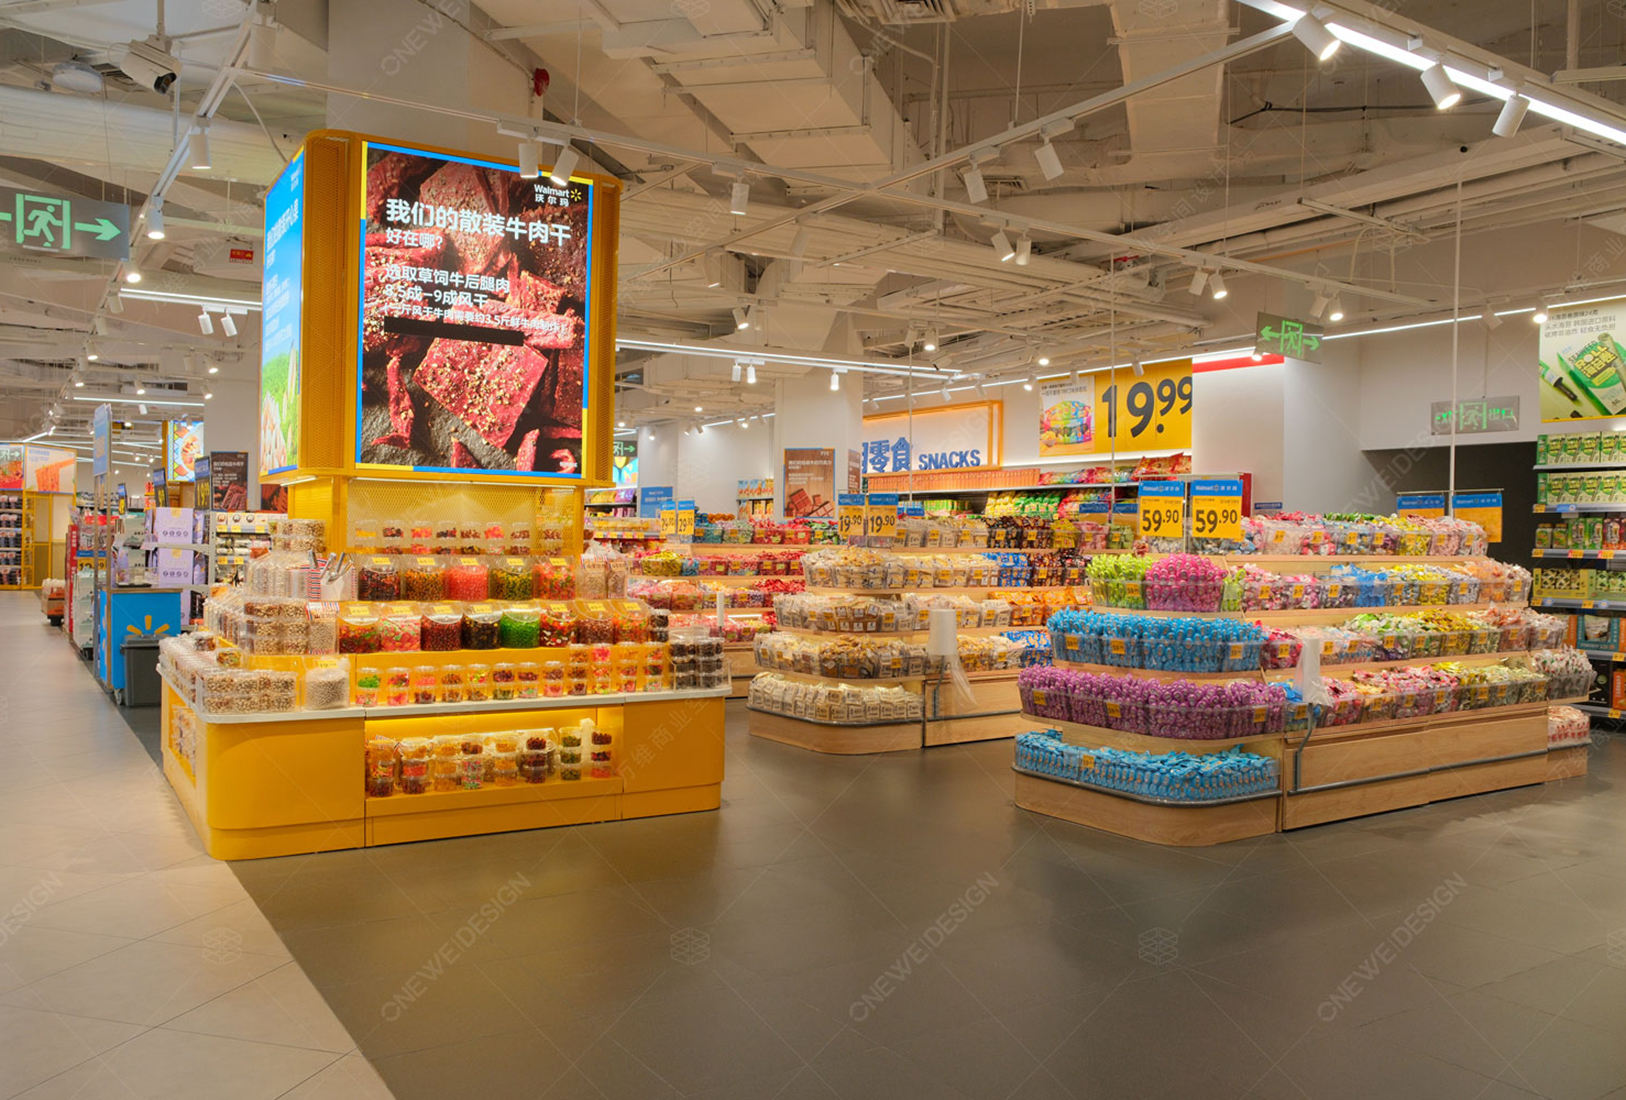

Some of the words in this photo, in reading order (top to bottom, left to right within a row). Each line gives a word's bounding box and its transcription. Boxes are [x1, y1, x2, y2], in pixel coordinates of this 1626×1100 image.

[534, 184, 570, 198] Walmart
[535, 194, 570, 207] 沃尔玛
[386, 198, 572, 247] 我们的散装牛肉干
[384, 264, 510, 294] 选取草饲牛后腿肉
[1568, 340, 1599, 364] SEAWEED
[1574, 345, 1609, 370] ROLL
[1102, 376, 1192, 438] 19.99
[918, 449, 981, 471] SNACKS
[839, 515, 862, 533] 19.90
[870, 515, 895, 534] 19.90
[1142, 509, 1179, 532] 59.90
[1195, 509, 1238, 534] 59.90
